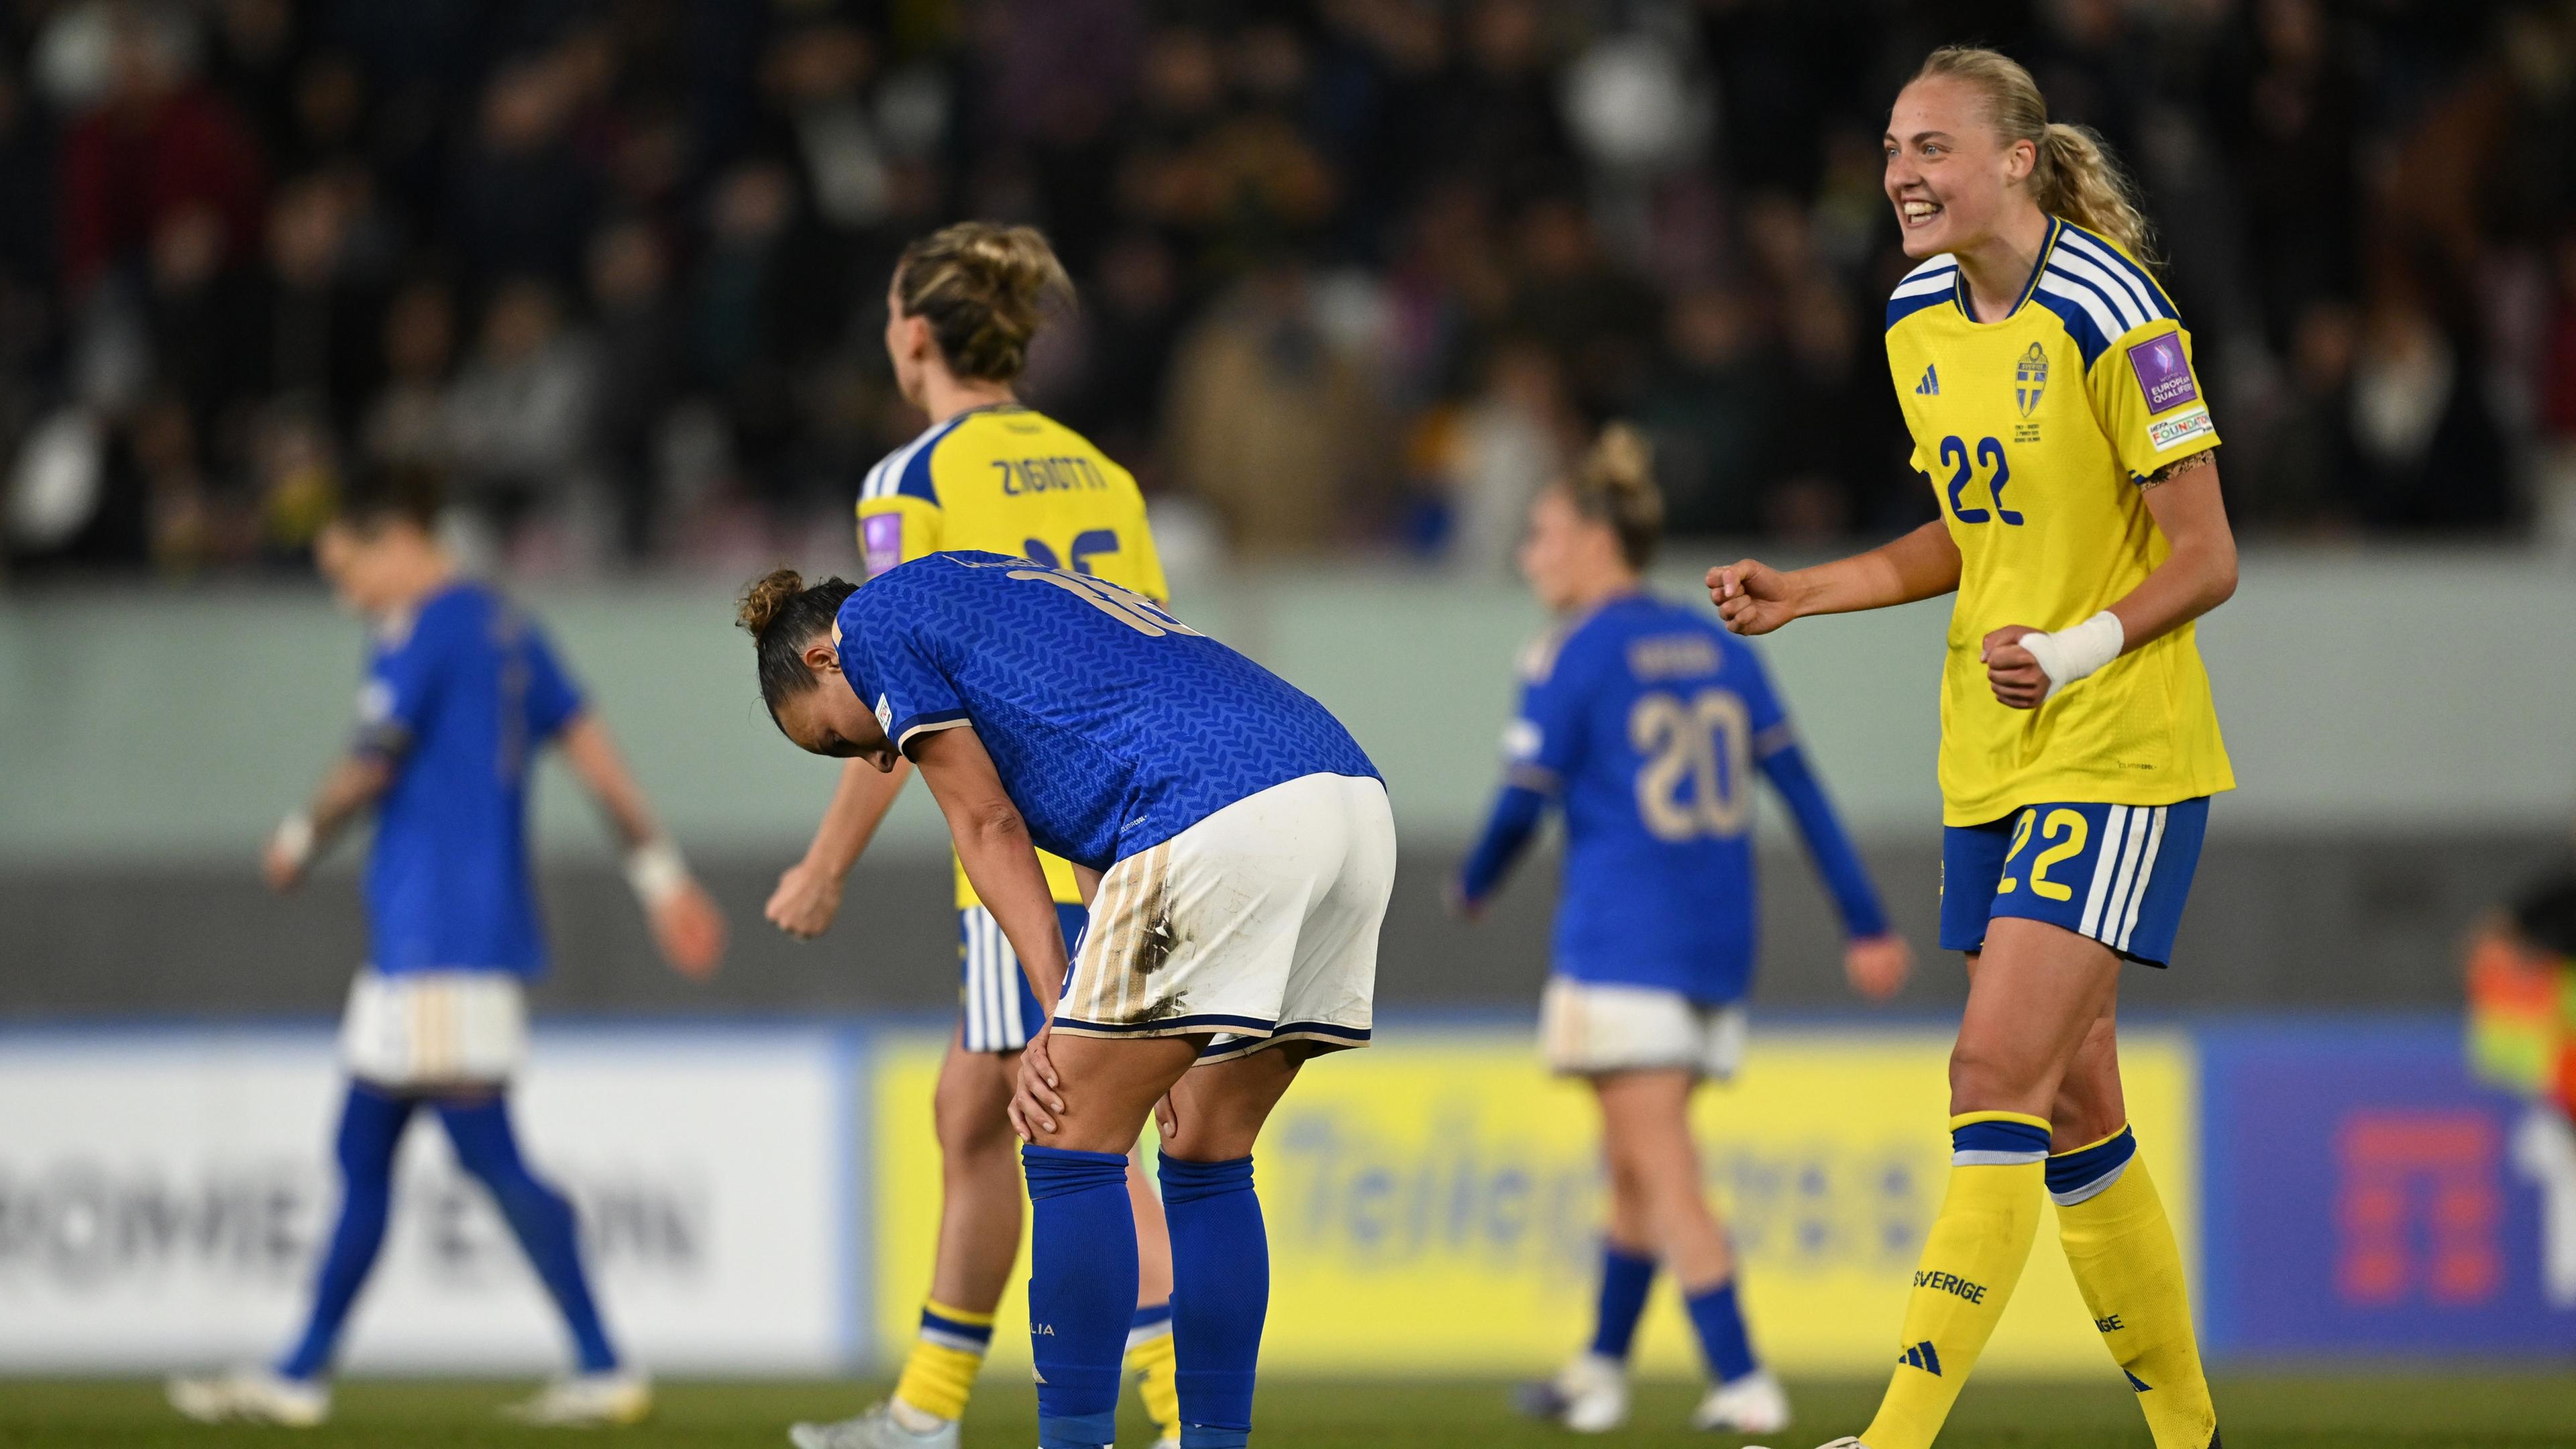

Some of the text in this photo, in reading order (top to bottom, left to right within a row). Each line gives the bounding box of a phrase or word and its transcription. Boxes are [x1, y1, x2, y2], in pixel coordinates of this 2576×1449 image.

[991, 458, 1109, 496] ZIGIOTTI
[1939, 435, 2025, 526] 22
[1630, 690, 1752, 841] 20
[1997, 808, 2088, 902] 22
[1913, 1271, 1988, 1305] SVERIGE
